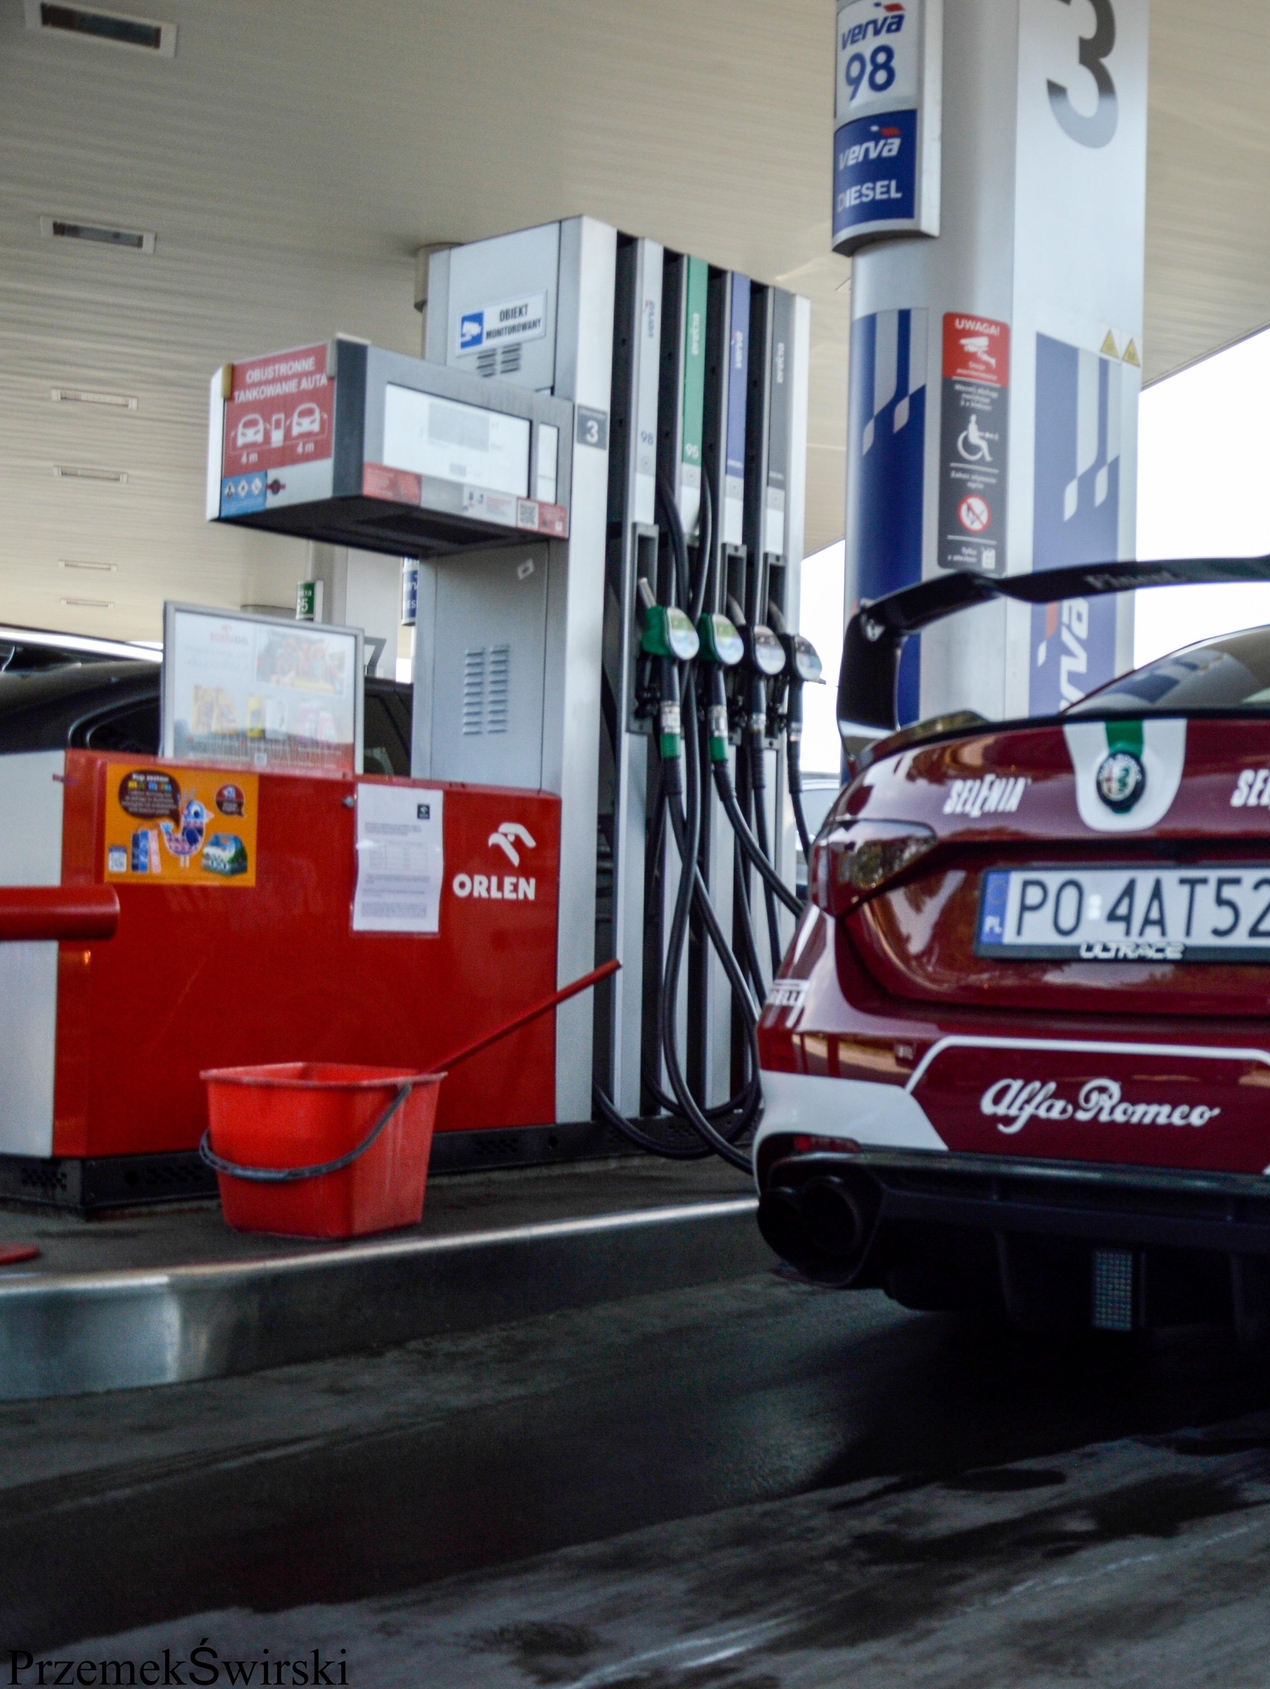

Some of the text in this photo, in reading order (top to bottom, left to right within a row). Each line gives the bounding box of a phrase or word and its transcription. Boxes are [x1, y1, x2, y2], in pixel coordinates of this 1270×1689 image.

[841, 12, 905, 50] verva
[845, 44, 896, 102] 98
[1047, 0, 1119, 149] 3
[838, 137, 901, 171] verva
[837, 179, 902, 213] DIESEL
[499, 303, 528, 323] OBIEKT
[954, 317, 1000, 336] UWAGA!
[485, 317, 541, 340] MONITOROWANY
[246, 356, 316, 384] OBUSTRONNE
[234, 373, 328, 404] TANKOWANIE AUTA
[585, 420, 598, 443] 3
[640, 431, 654, 446] 98
[241, 452, 258, 464] 4 m
[296, 441, 314, 454] 4 m
[685, 443, 699, 460] 95
[1059, 597, 1089, 712] rva
[943, 773, 1027, 818] SELENIA
[453, 873, 536, 900] ORLEN
[1016, 878, 1084, 938] PO
[1079, 941, 1184, 960] ULTRACE
[980, 1078, 1221, 1135] Alfa Romeo
